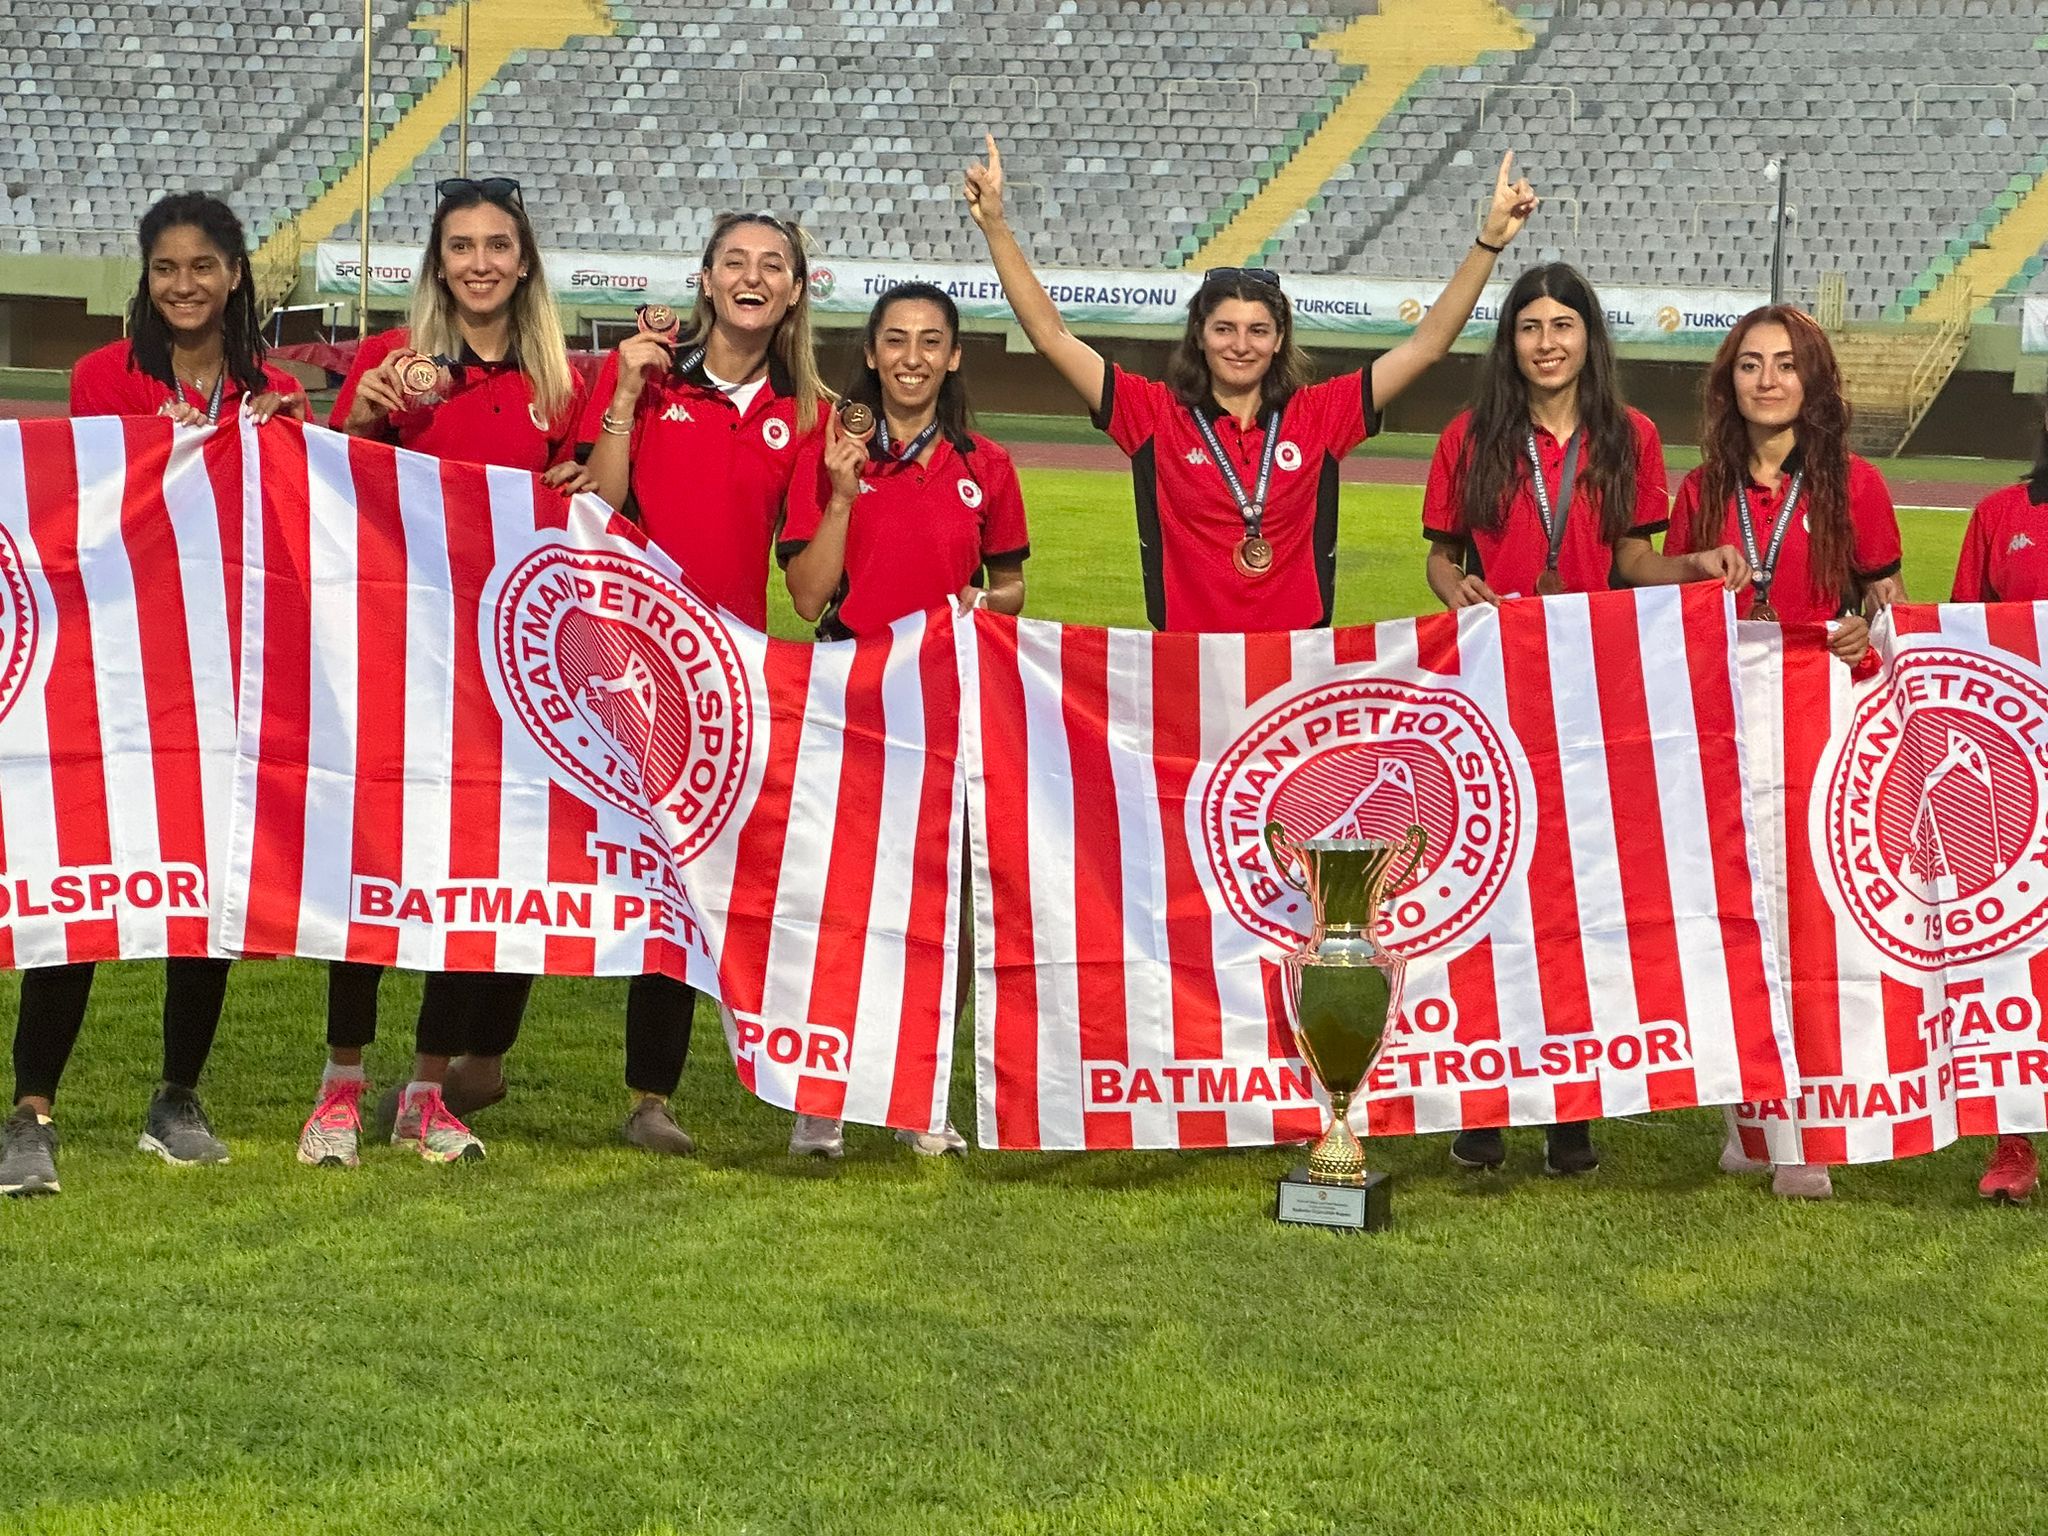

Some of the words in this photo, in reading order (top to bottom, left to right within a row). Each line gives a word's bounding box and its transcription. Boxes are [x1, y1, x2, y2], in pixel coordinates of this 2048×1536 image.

[571, 274, 647, 287] SPORTOTO
[1043, 285, 1177, 306] EDERASYONU
[1295, 299, 1372, 316] TURKCELL
[1683, 312, 1743, 328] TURKC
[520, 571, 574, 724] BATMAN
[573, 576, 724, 825] PETROLSPOR
[1229, 735, 1301, 908] BATMAN
[1303, 706, 1492, 877] PETROLSPOR
[1850, 717, 1899, 912] BATMAN
[0, 871, 201, 919] LSPOR
[360, 884, 591, 929] BATMAN
[1923, 897, 2005, 942] 1960
[1924, 996, 2033, 1051] TPAO
[1091, 1066, 1313, 1103] BATMAN
[1367, 1027, 1683, 1092] ETROLSPOR
